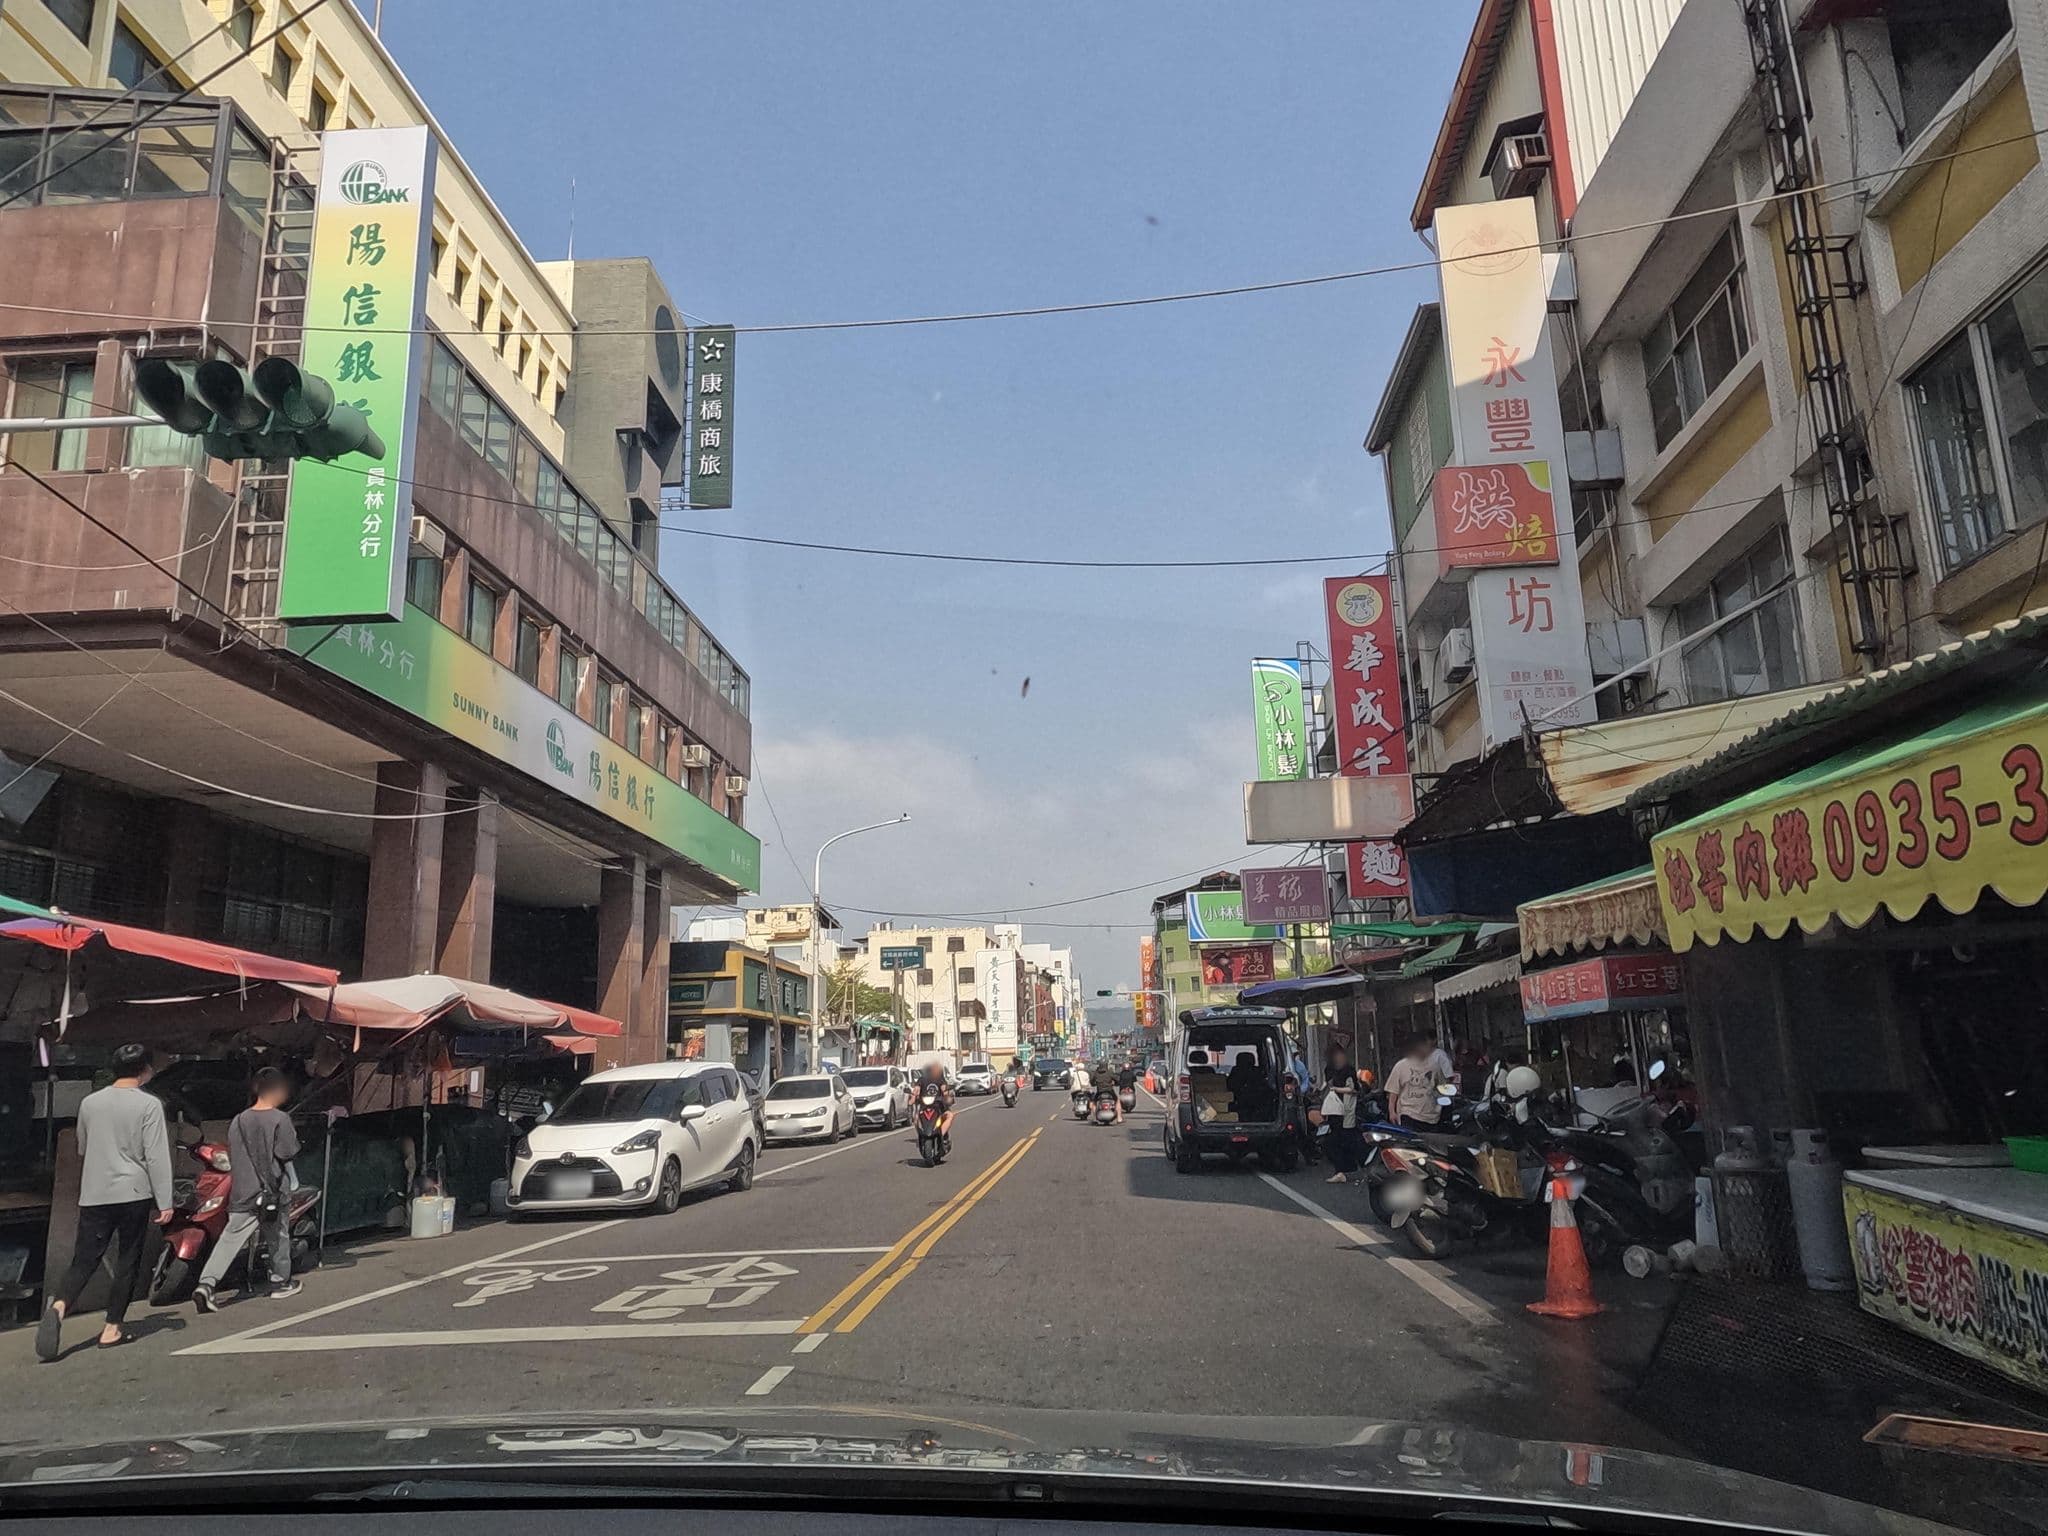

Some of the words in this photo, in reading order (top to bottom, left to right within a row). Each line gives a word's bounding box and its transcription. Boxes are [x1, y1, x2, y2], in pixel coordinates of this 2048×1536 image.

[699, 373, 723, 476] 康橋商旅
[360, 467, 386, 558] 員林分行
[1505, 576, 1554, 633] 坊
[453, 692, 489, 725] SUNNY
[492, 715, 519, 742] BANK
[1343, 631, 1406, 887] 華成牛麵
[588, 750, 656, 821] 陽信銀行
[1823, 743, 2048, 883] 0935-3
